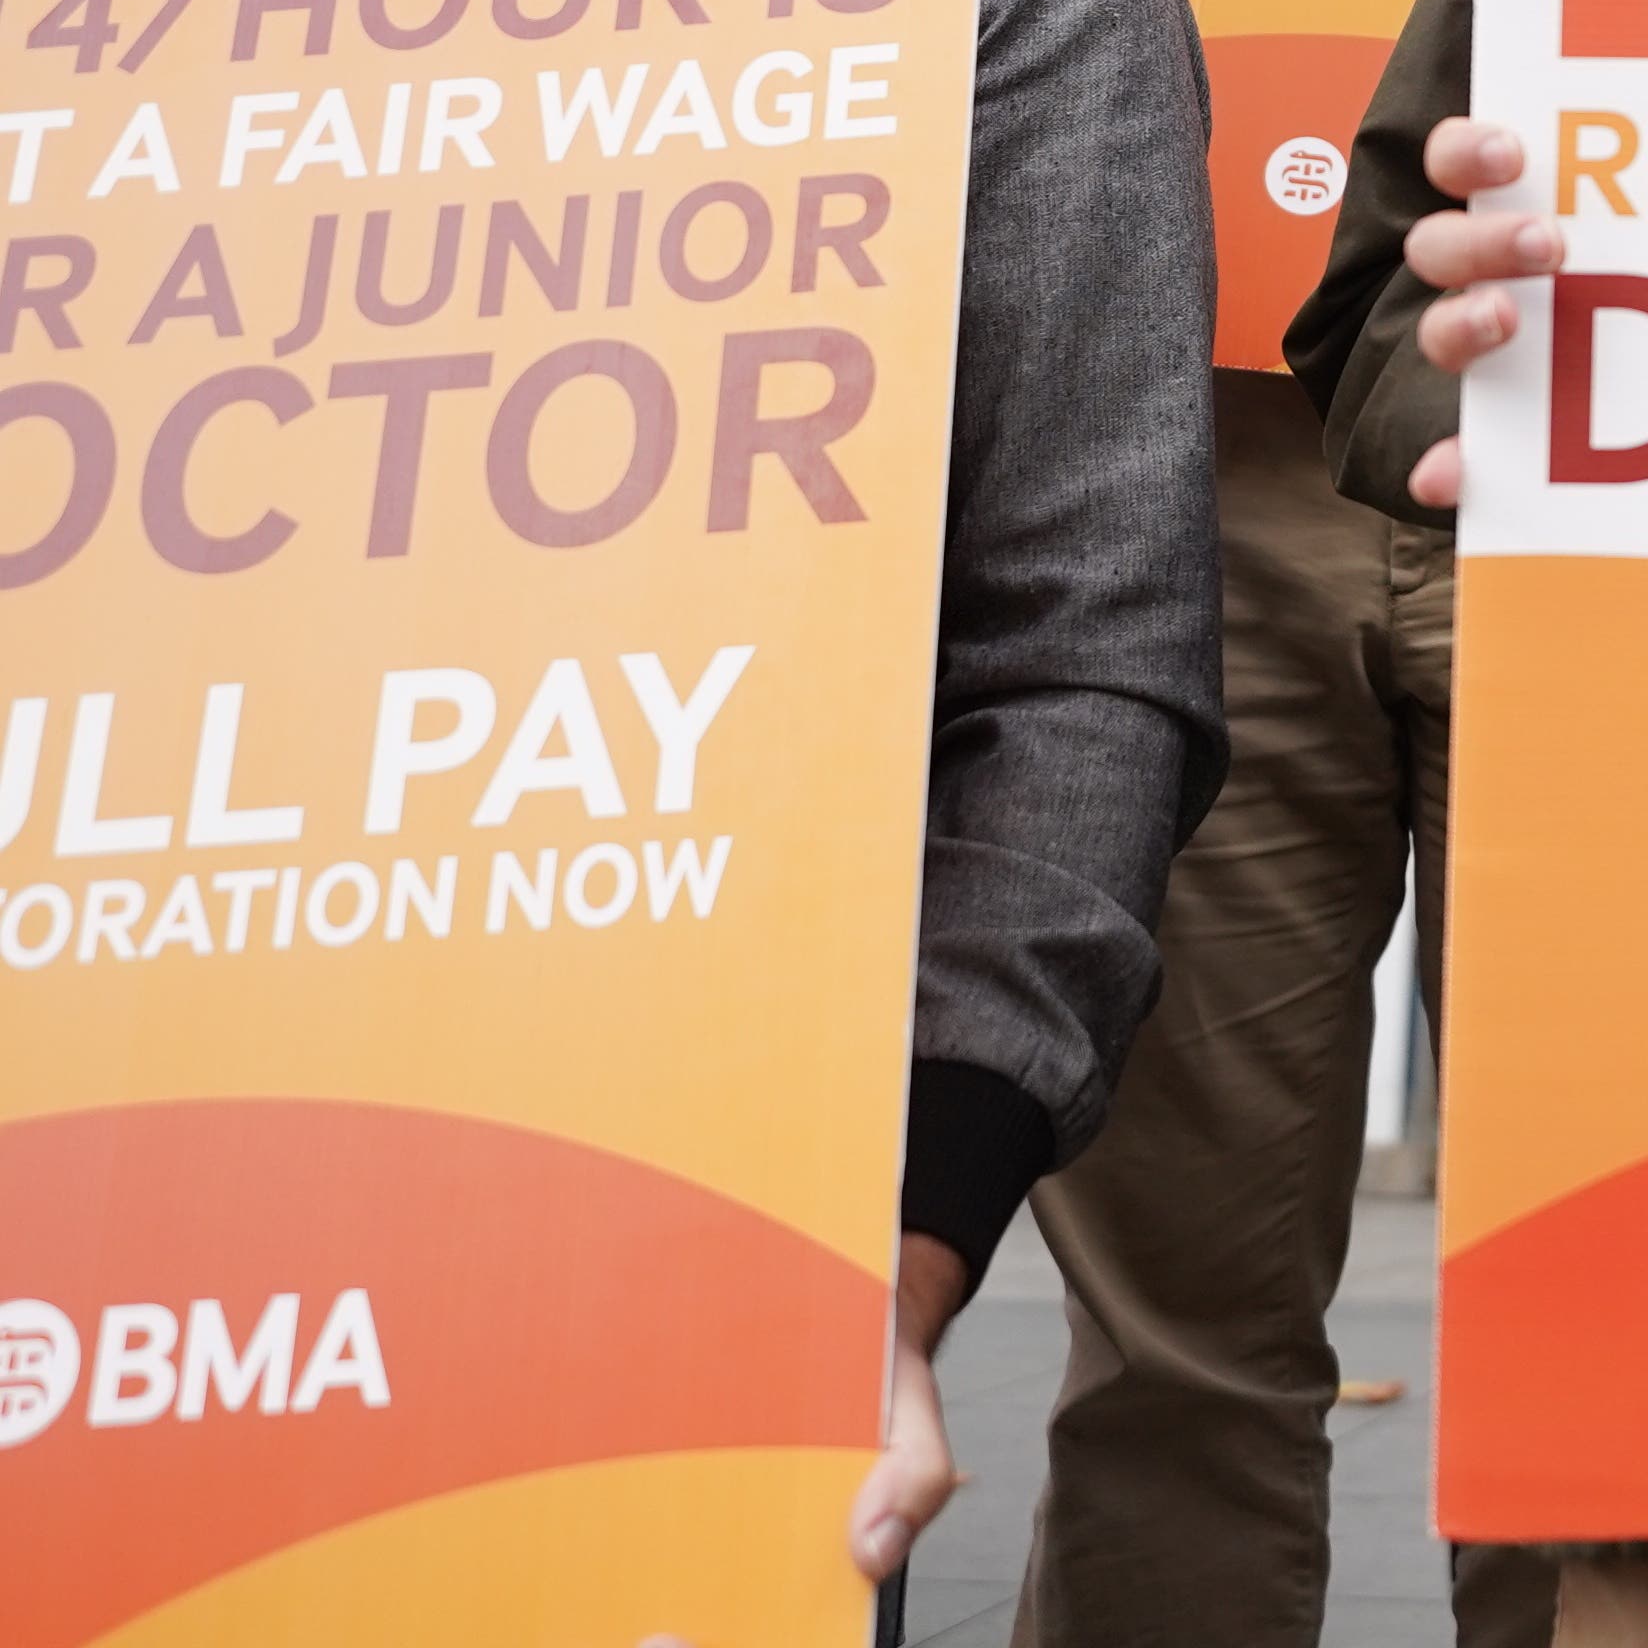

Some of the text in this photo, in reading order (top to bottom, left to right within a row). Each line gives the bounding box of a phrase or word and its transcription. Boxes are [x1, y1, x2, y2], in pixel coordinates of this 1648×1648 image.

[86, 101, 181, 200] A
[217, 75, 505, 188] FAIR
[535, 41, 901, 163] WAGE
[127, 223, 246, 345] A
[271, 171, 893, 358] JUNIOR
[0, 324, 878, 592] OCTOR
[364, 643, 758, 835] PAY
[0, 834, 734, 970] ORATION NOW
[87, 1286, 392, 1430] BMA
